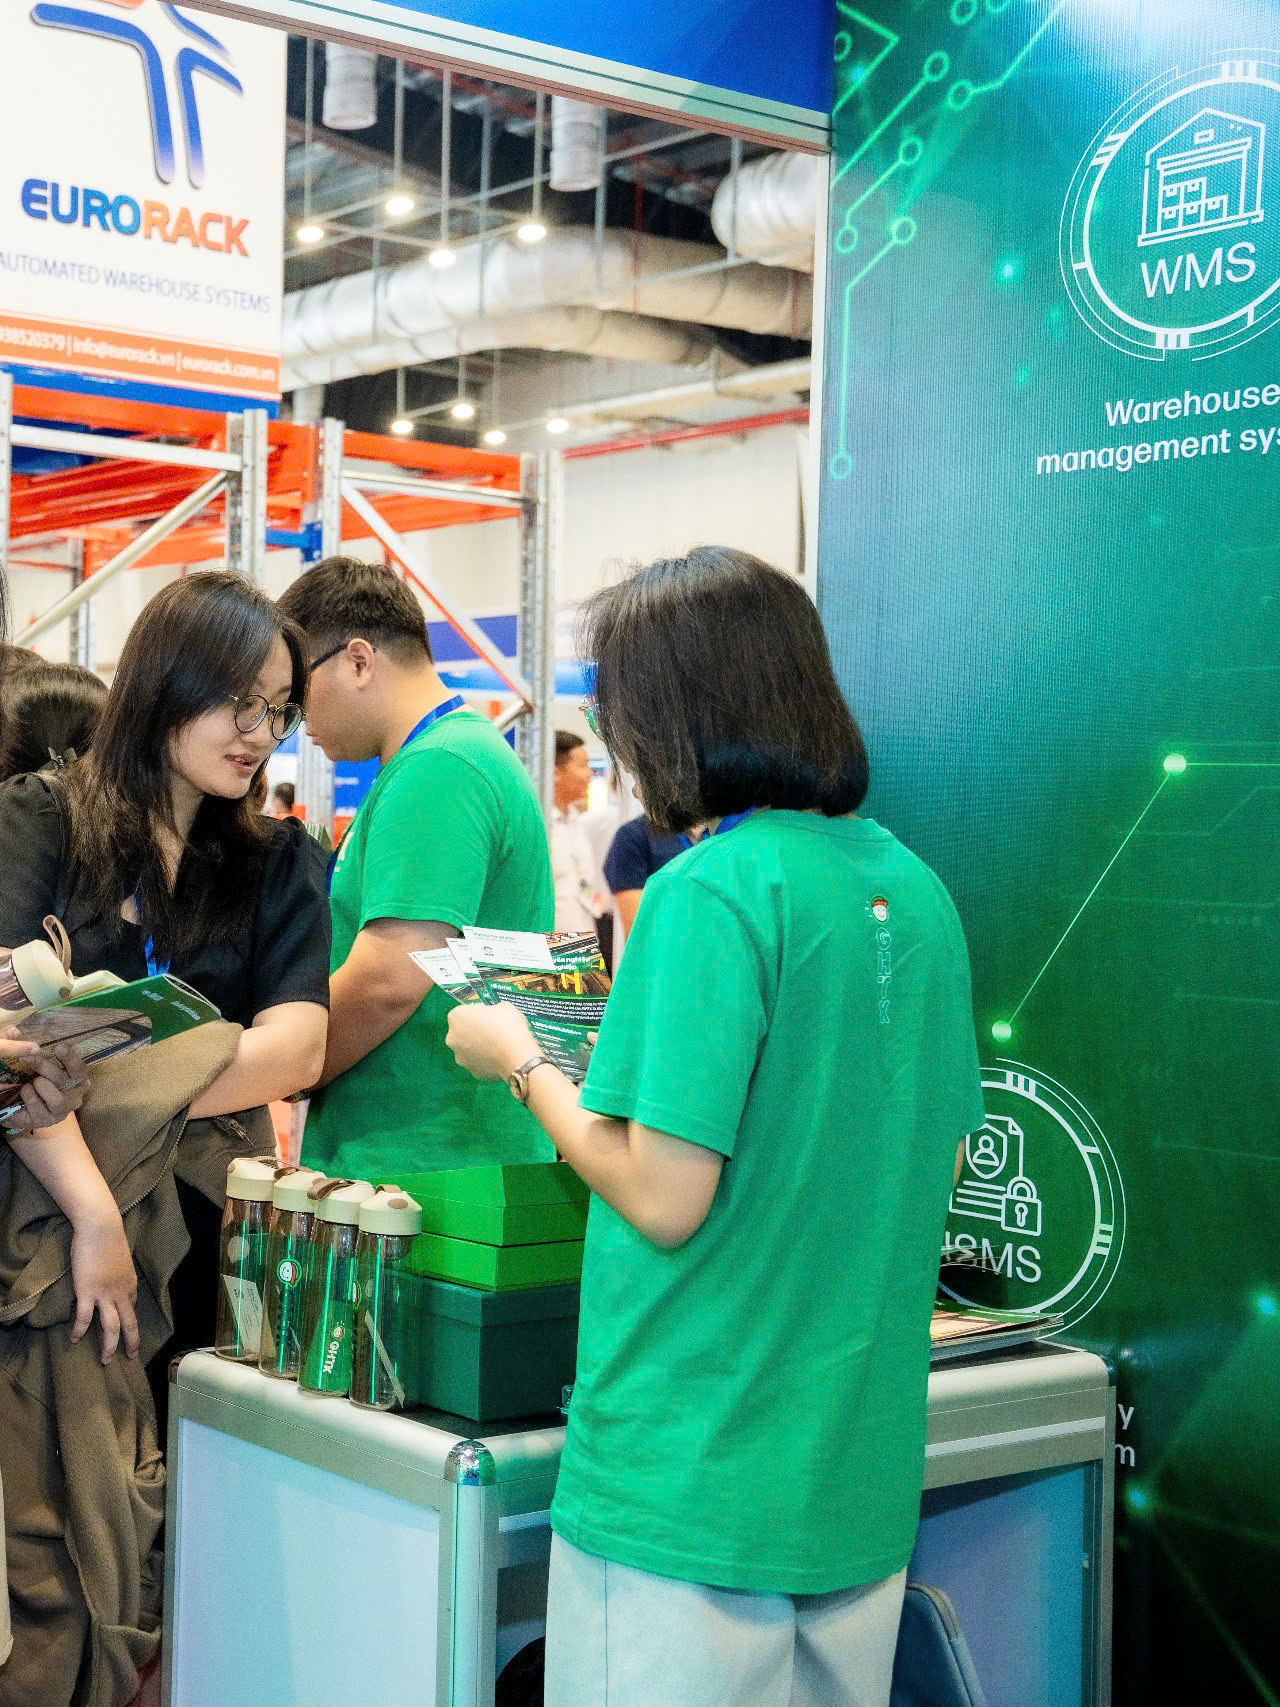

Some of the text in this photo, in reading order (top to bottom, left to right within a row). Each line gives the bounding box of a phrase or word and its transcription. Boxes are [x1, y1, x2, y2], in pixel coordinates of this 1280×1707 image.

[21, 178, 249, 257] EURORACK
[104, 268, 201, 302] WAREHOUSE
[205, 285, 271, 314] SYSTEMS
[1141, 241, 1257, 298] WMS
[1105, 384, 1280, 427] Warehouse
[1036, 428, 1232, 475] management
[322, 1340, 340, 1375] GHTK
